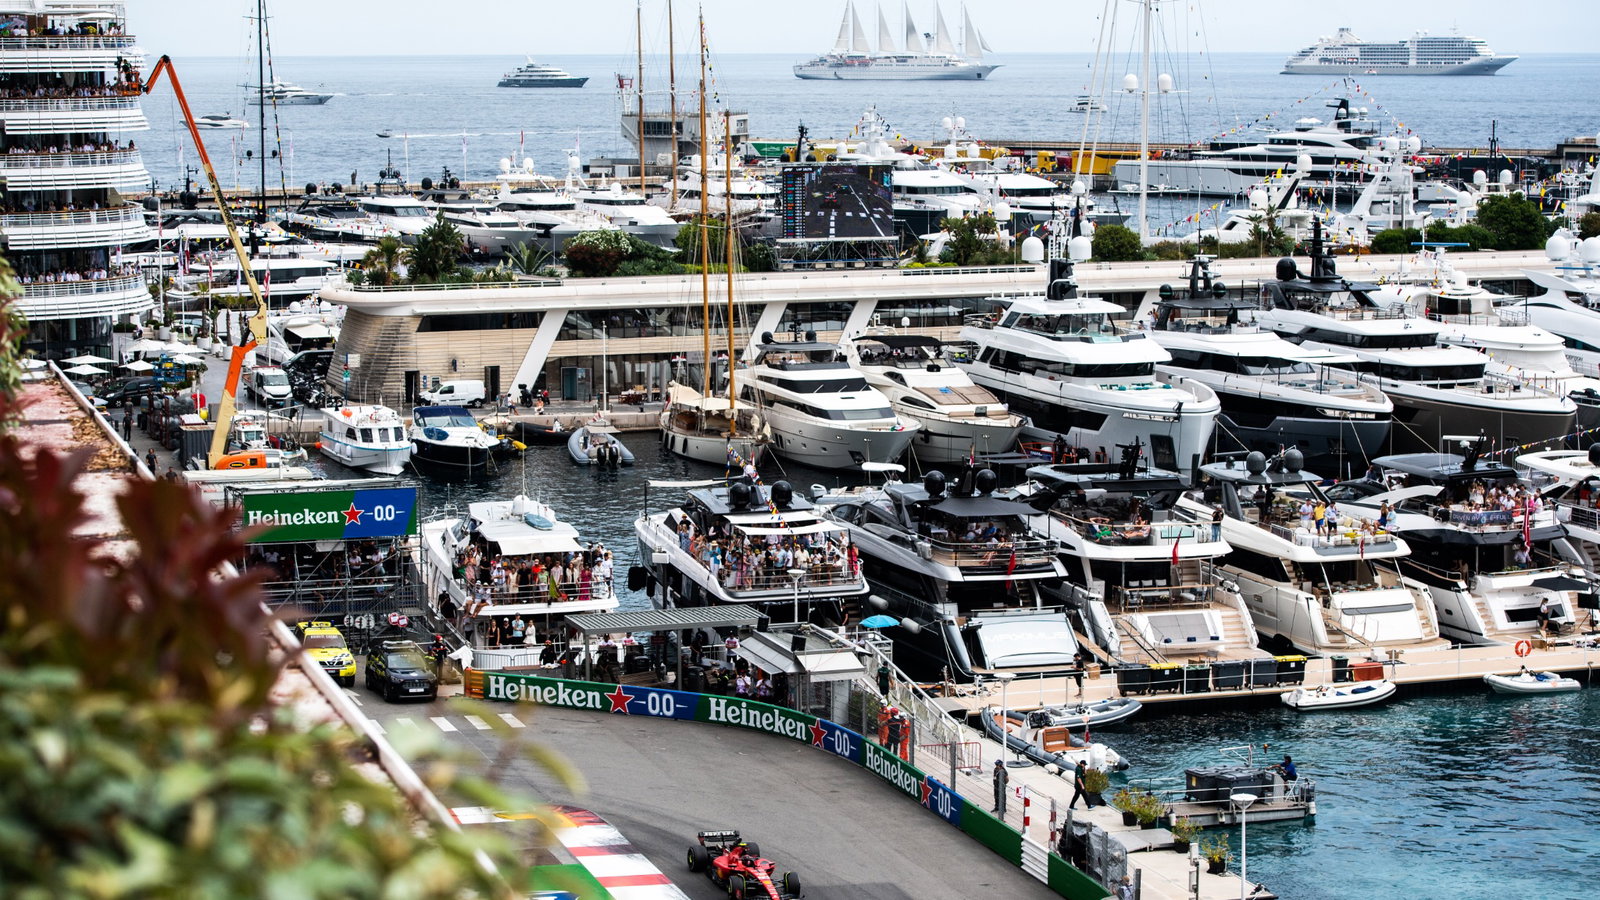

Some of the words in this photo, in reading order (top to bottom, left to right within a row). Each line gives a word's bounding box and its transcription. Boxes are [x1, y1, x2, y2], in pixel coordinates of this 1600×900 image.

[248, 508, 339, 527] Heineken
[488, 675, 602, 709] Heineken
[708, 697, 807, 741] Heineken
[865, 743, 918, 796] Heineken
